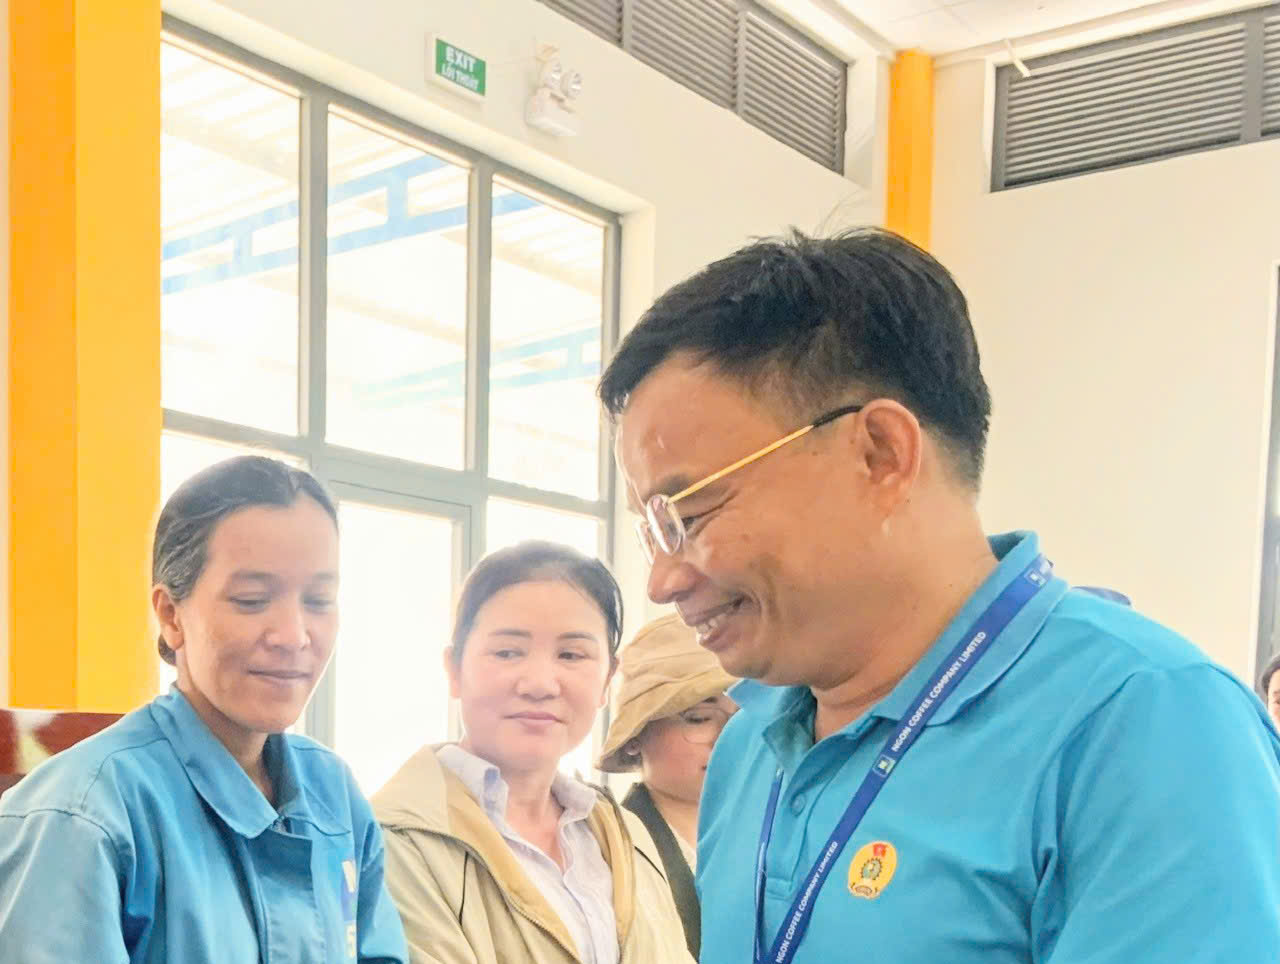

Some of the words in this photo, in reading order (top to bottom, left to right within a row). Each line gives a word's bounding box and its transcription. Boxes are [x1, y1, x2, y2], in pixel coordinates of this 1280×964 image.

[445, 46, 477, 73] EXIT
[891, 726, 912, 752] NGON
[908, 698, 933, 727] COFFEE
[929, 660, 962, 698] COMPANY
[958, 631, 986, 663] LIMITED
[775, 940, 790, 963] NGON
[785, 911, 802, 940] COFFEE
[798, 871, 820, 911] COMPANY
[817, 841, 838, 873] LIMITED
